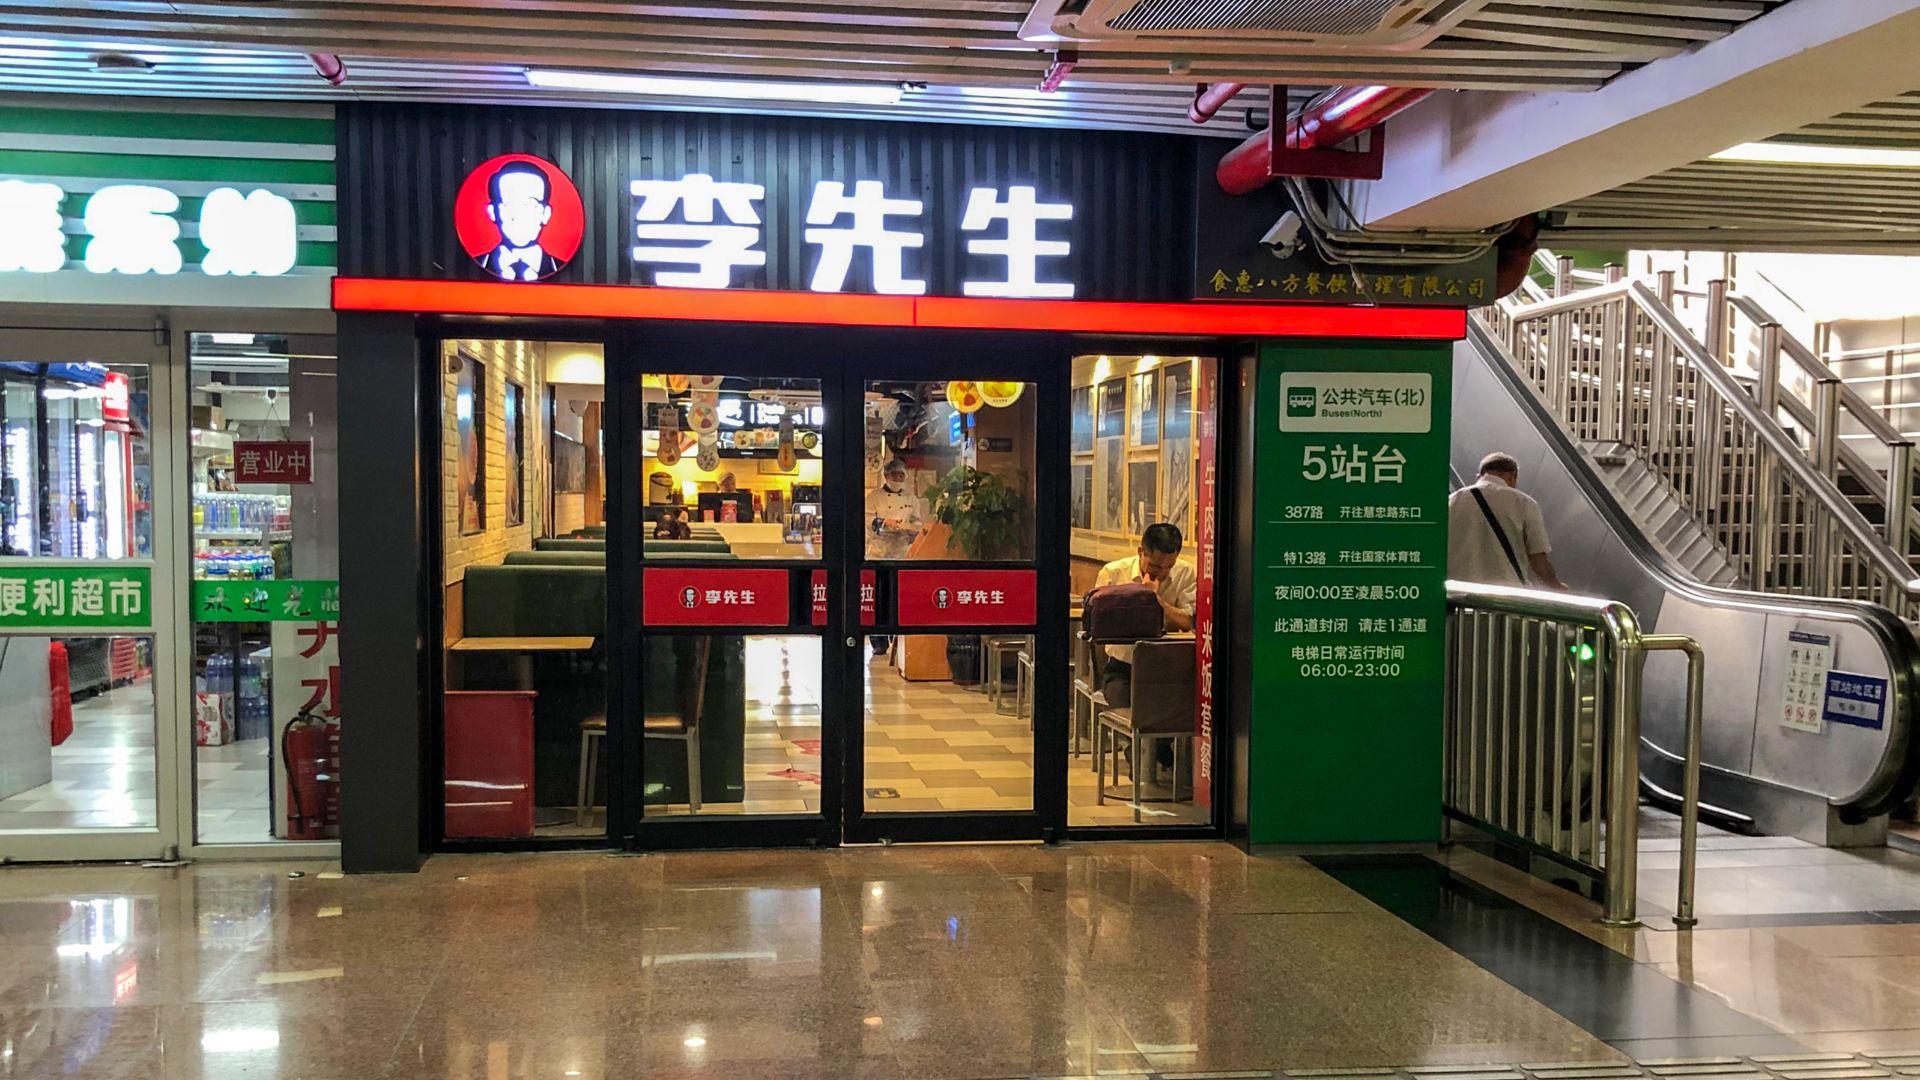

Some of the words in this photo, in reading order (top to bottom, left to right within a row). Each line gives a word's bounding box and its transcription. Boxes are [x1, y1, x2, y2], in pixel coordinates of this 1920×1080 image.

[629, 172, 1076, 300] 李先生
[1322, 387, 1426, 407] 公共汽车(北)
[1321, 409, 1383, 418] Buses(North)
[239, 450, 307, 476] 营业中
[1302, 443, 1408, 484] 5站台
[1284, 505, 1324, 519] 387路
[1340, 506, 1422, 519] 开往慧忠路东口
[1283, 551, 1326, 565] 特13路
[1338, 550, 1421, 563] 开往国家体育馆
[0, 576, 143, 617] 便利超市
[705, 589, 756, 605] 李先生
[813, 583, 827, 602] 拉
[860, 583, 875, 602] 拉
[956, 589, 1005, 605] 李先生
[1274, 585, 1420, 600] 夜间0:00至凌晨5:00
[1274, 617, 1348, 633] 此通道封闭
[1358, 617, 1427, 633] 请走1通道
[1291, 645, 1405, 661] 电梯日常运行时间
[1300, 663, 1400, 677] 06:00-23:00
